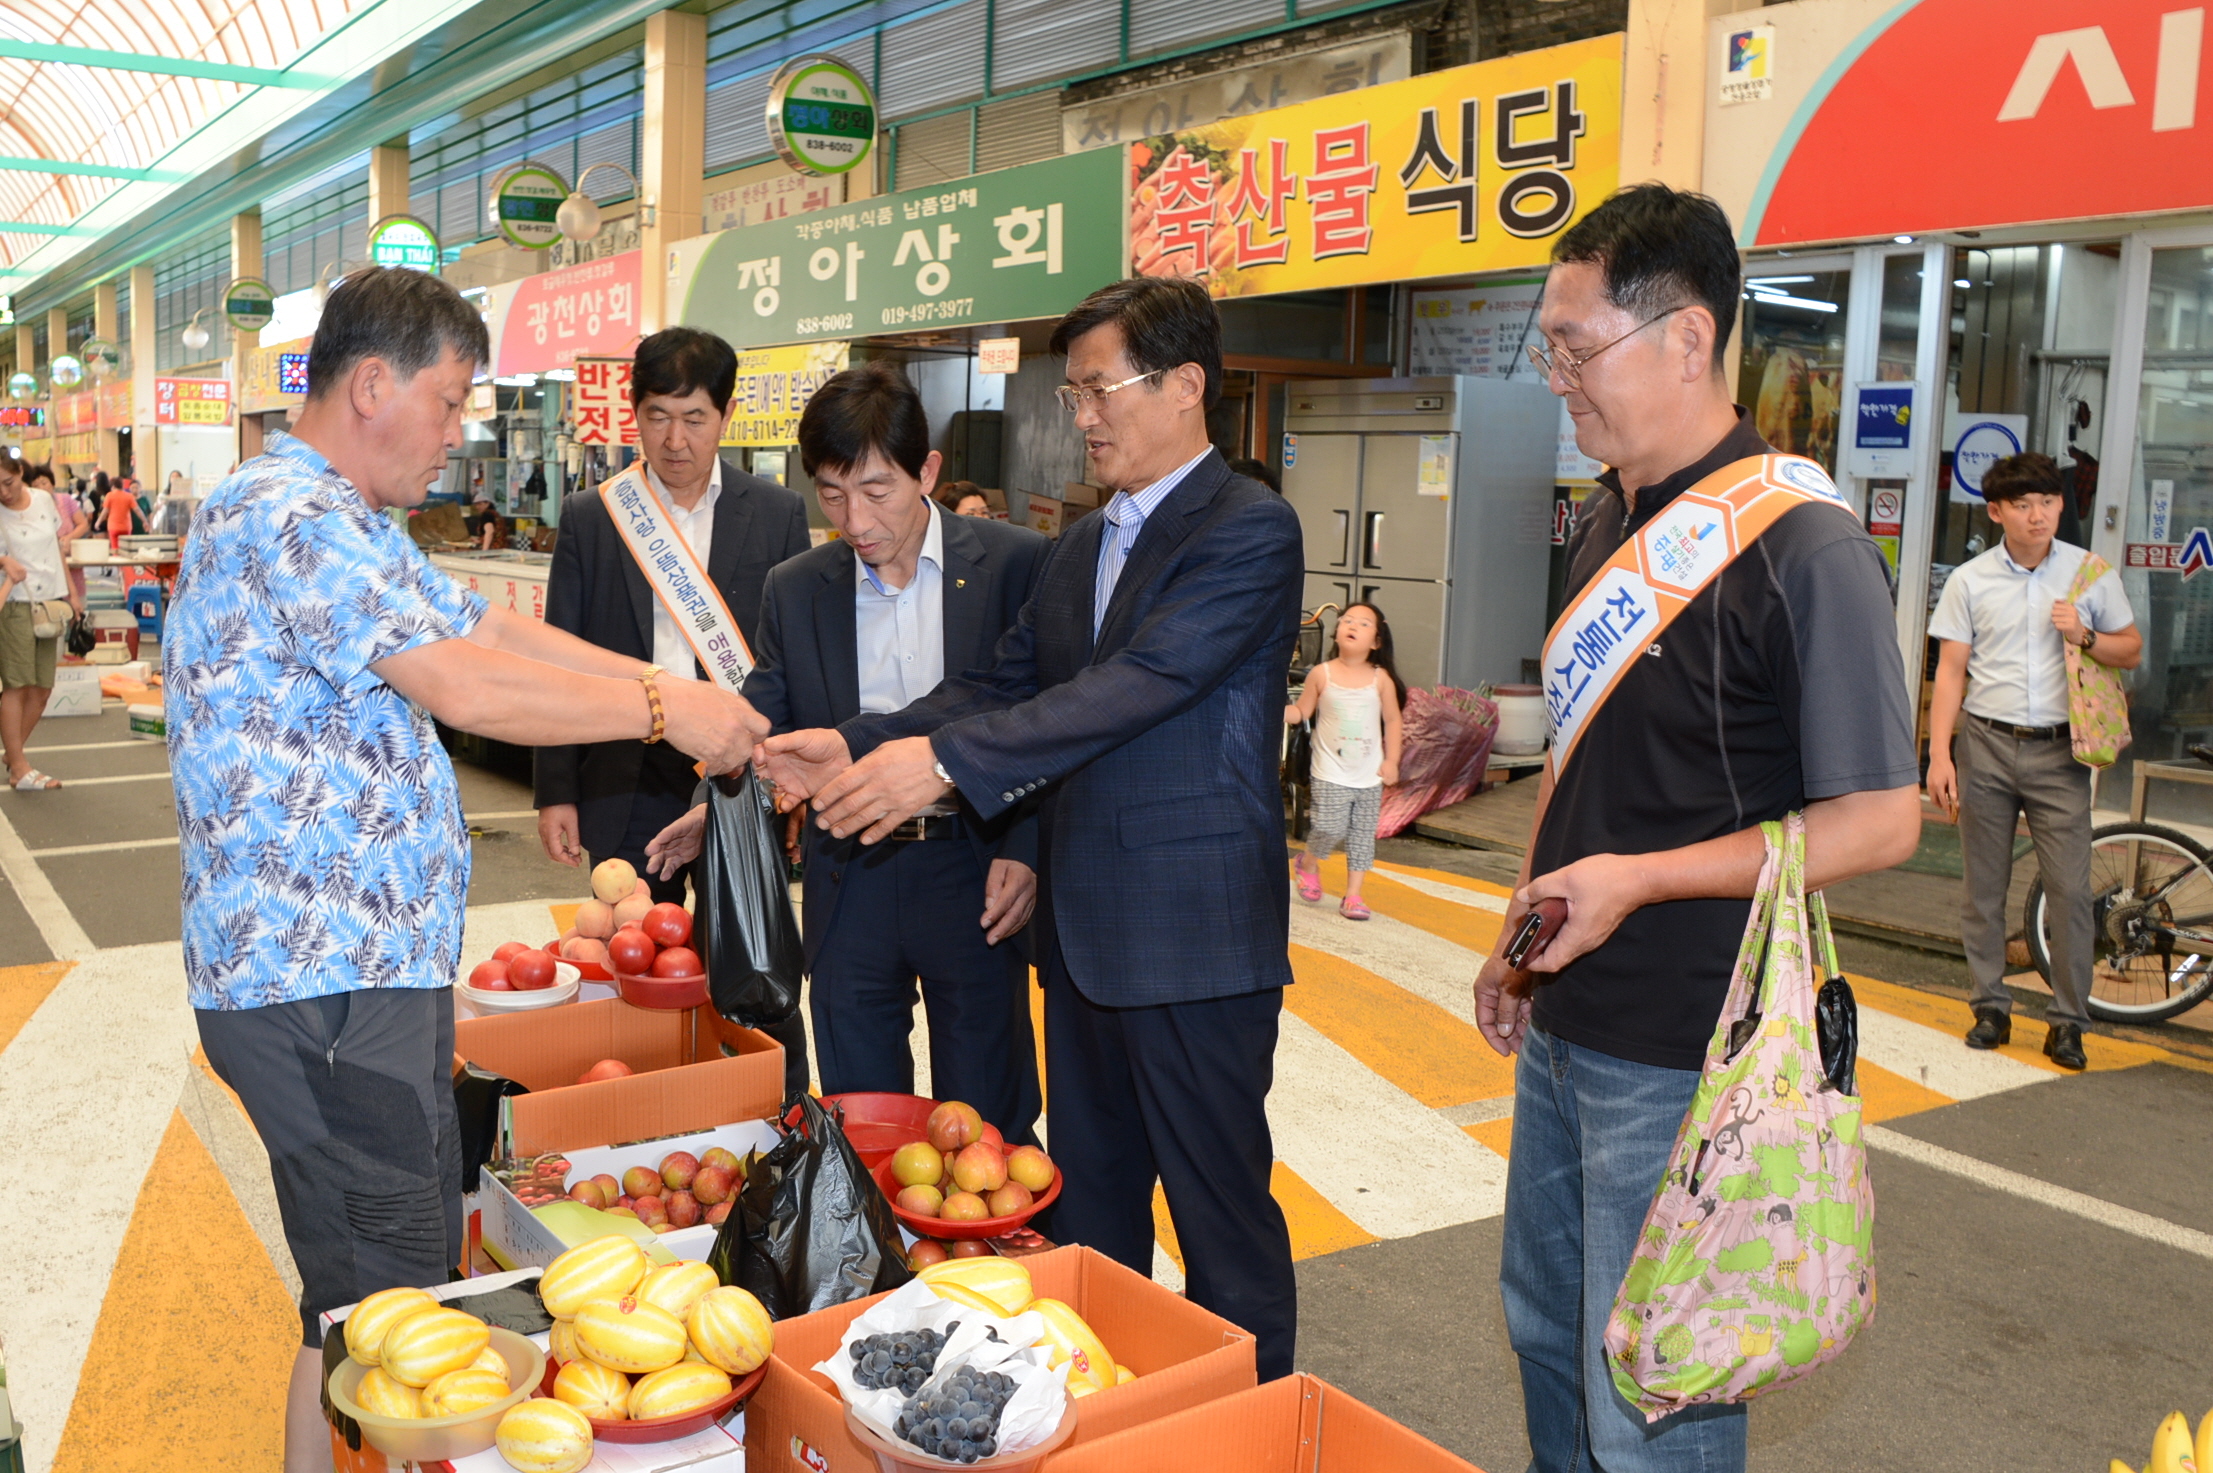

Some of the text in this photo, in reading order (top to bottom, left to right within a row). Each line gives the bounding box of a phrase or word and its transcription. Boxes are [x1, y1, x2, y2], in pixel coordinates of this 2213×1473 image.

[788, 104, 869, 132] 정아상회
[806, 139, 853, 153] 838-6002
[1155, 80, 1585, 275] 축산물 식당
[903, 188, 977, 220] 납품업체
[737, 202, 1063, 317] 정아상회
[526, 282, 632, 345] 광천상회
[796, 297, 974, 335] 838-6002 019-497-3977
[614, 477, 744, 692] 증평사랑 으뜸상품권을 애용합
